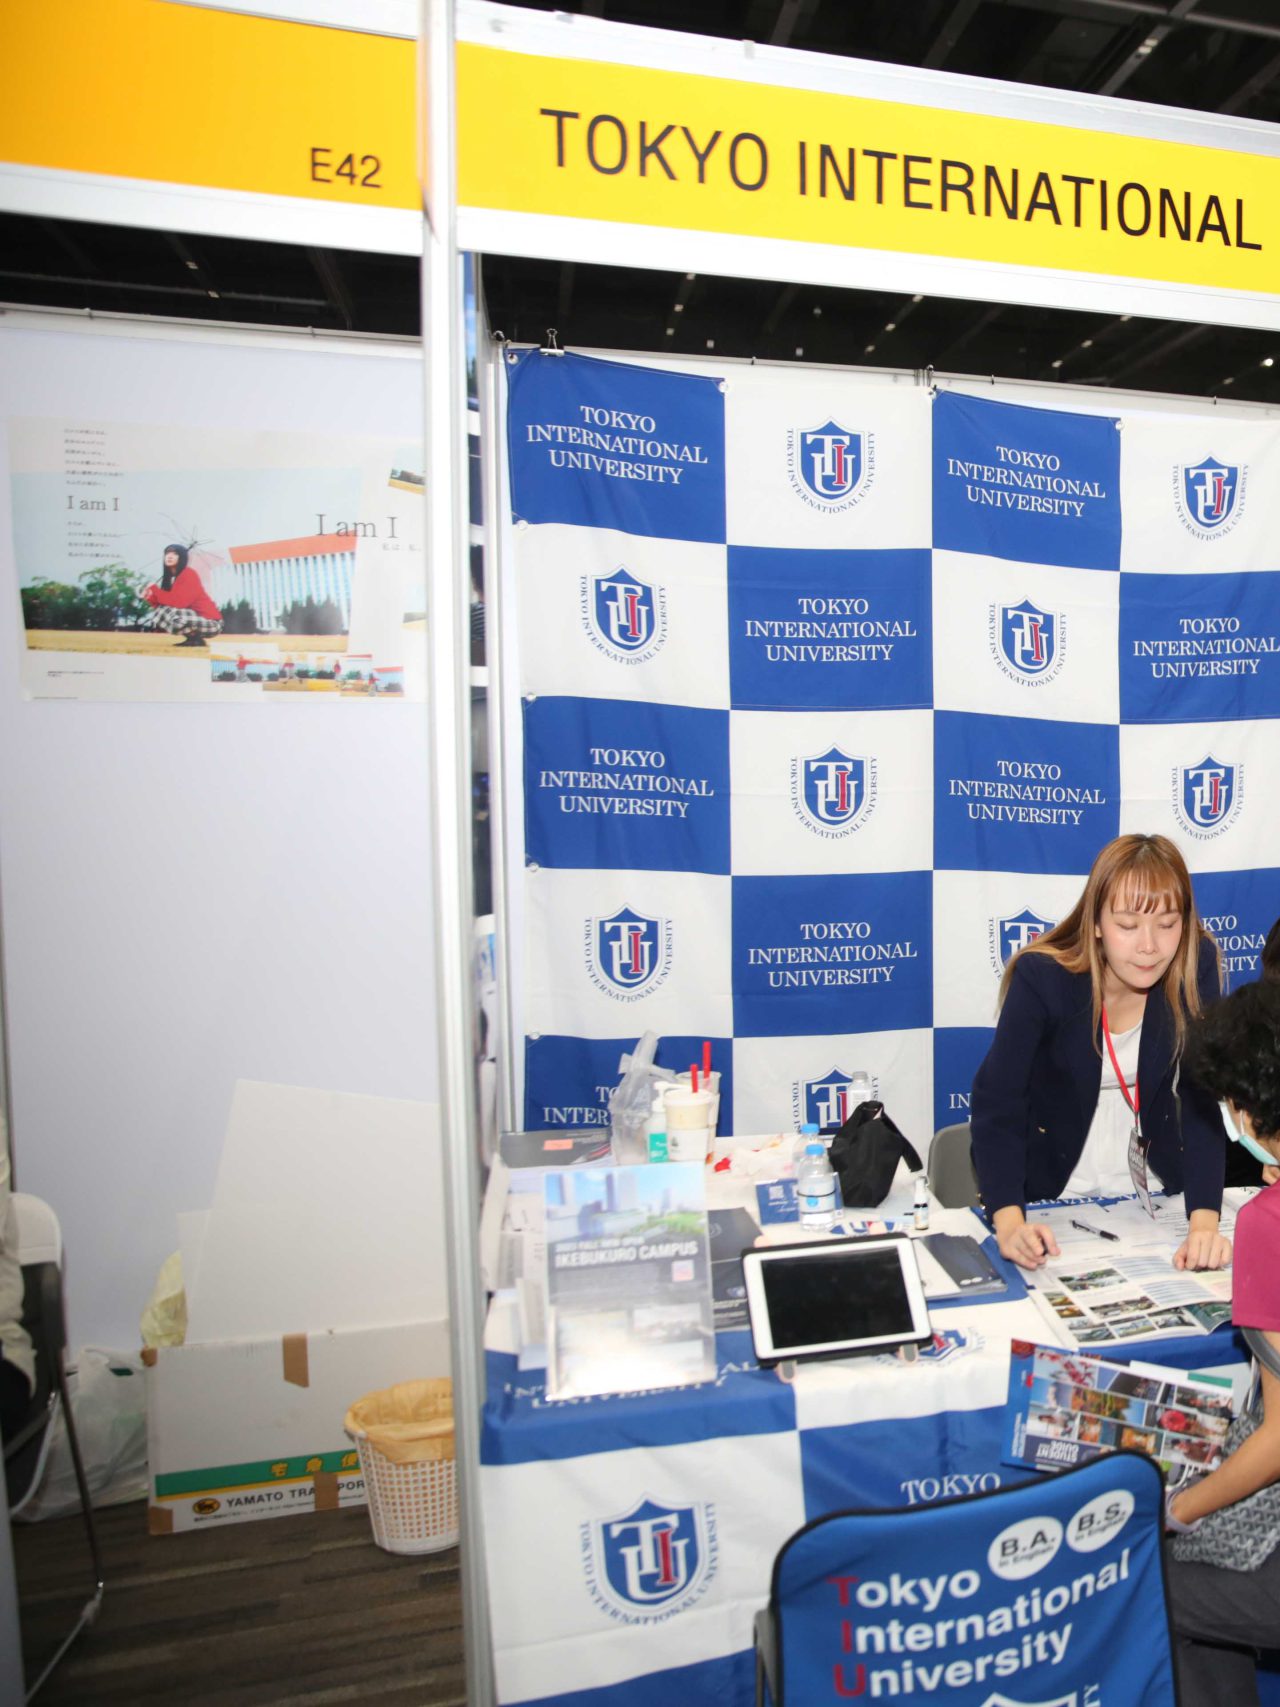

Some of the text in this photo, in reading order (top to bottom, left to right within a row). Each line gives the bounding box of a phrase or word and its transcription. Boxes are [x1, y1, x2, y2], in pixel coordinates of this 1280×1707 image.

[310, 148, 382, 188] E42
[540, 109, 768, 191] TOKYO
[798, 141, 1262, 251] INTERNATIONAL
[580, 406, 656, 433] TOKYO
[527, 425, 708, 464] INTERNATIONAL
[549, 449, 683, 484] UNIVERSITY
[996, 446, 1060, 471] TOKYO
[948, 458, 1106, 498] INTERNATIONAL
[67, 495, 120, 512] I am I
[966, 485, 1085, 517] UNIVERSITY
[316, 514, 399, 539] I am I
[798, 599, 868, 615] TOKYO
[745, 620, 916, 638] INTERNATIONAL
[1180, 617, 1240, 634] TOKYO
[766, 644, 893, 662] UNIVERSITY
[1133, 637, 1280, 656] INTERNATIONAL
[1151, 659, 1260, 678] UNIVERSITY
[590, 748, 665, 768] TOKYO
[997, 761, 1061, 780] TOKYO
[539, 771, 714, 797] INTERNATIONAL
[949, 780, 1105, 805] INTERNATIONAL
[559, 796, 689, 818] UNIVERSITY
[791, 797, 860, 839] INTERNATIONAL
[861, 757, 877, 823] UNIVERSITY
[967, 803, 1083, 825] UNIVERSITY
[800, 922, 870, 940] TOKYO
[1202, 915, 1237, 932] KYO
[748, 942, 917, 965] INTERNATIONAL
[768, 965, 894, 988] UNIVERSITY
[555, 1240, 698, 1268] IKEBUKURO CAMPUS
[227, 1491, 283, 1508] YAMATO
[289, 1480, 365, 1499] TRAPOR
[901, 1473, 1000, 1505] TOKYO
[1077, 1502, 1126, 1532] B.S.
[1001, 1530, 1056, 1557] B.A.
[828, 1571, 979, 1612] Tokyo
[841, 1550, 1130, 1653] International
[834, 1625, 1072, 1698] University
